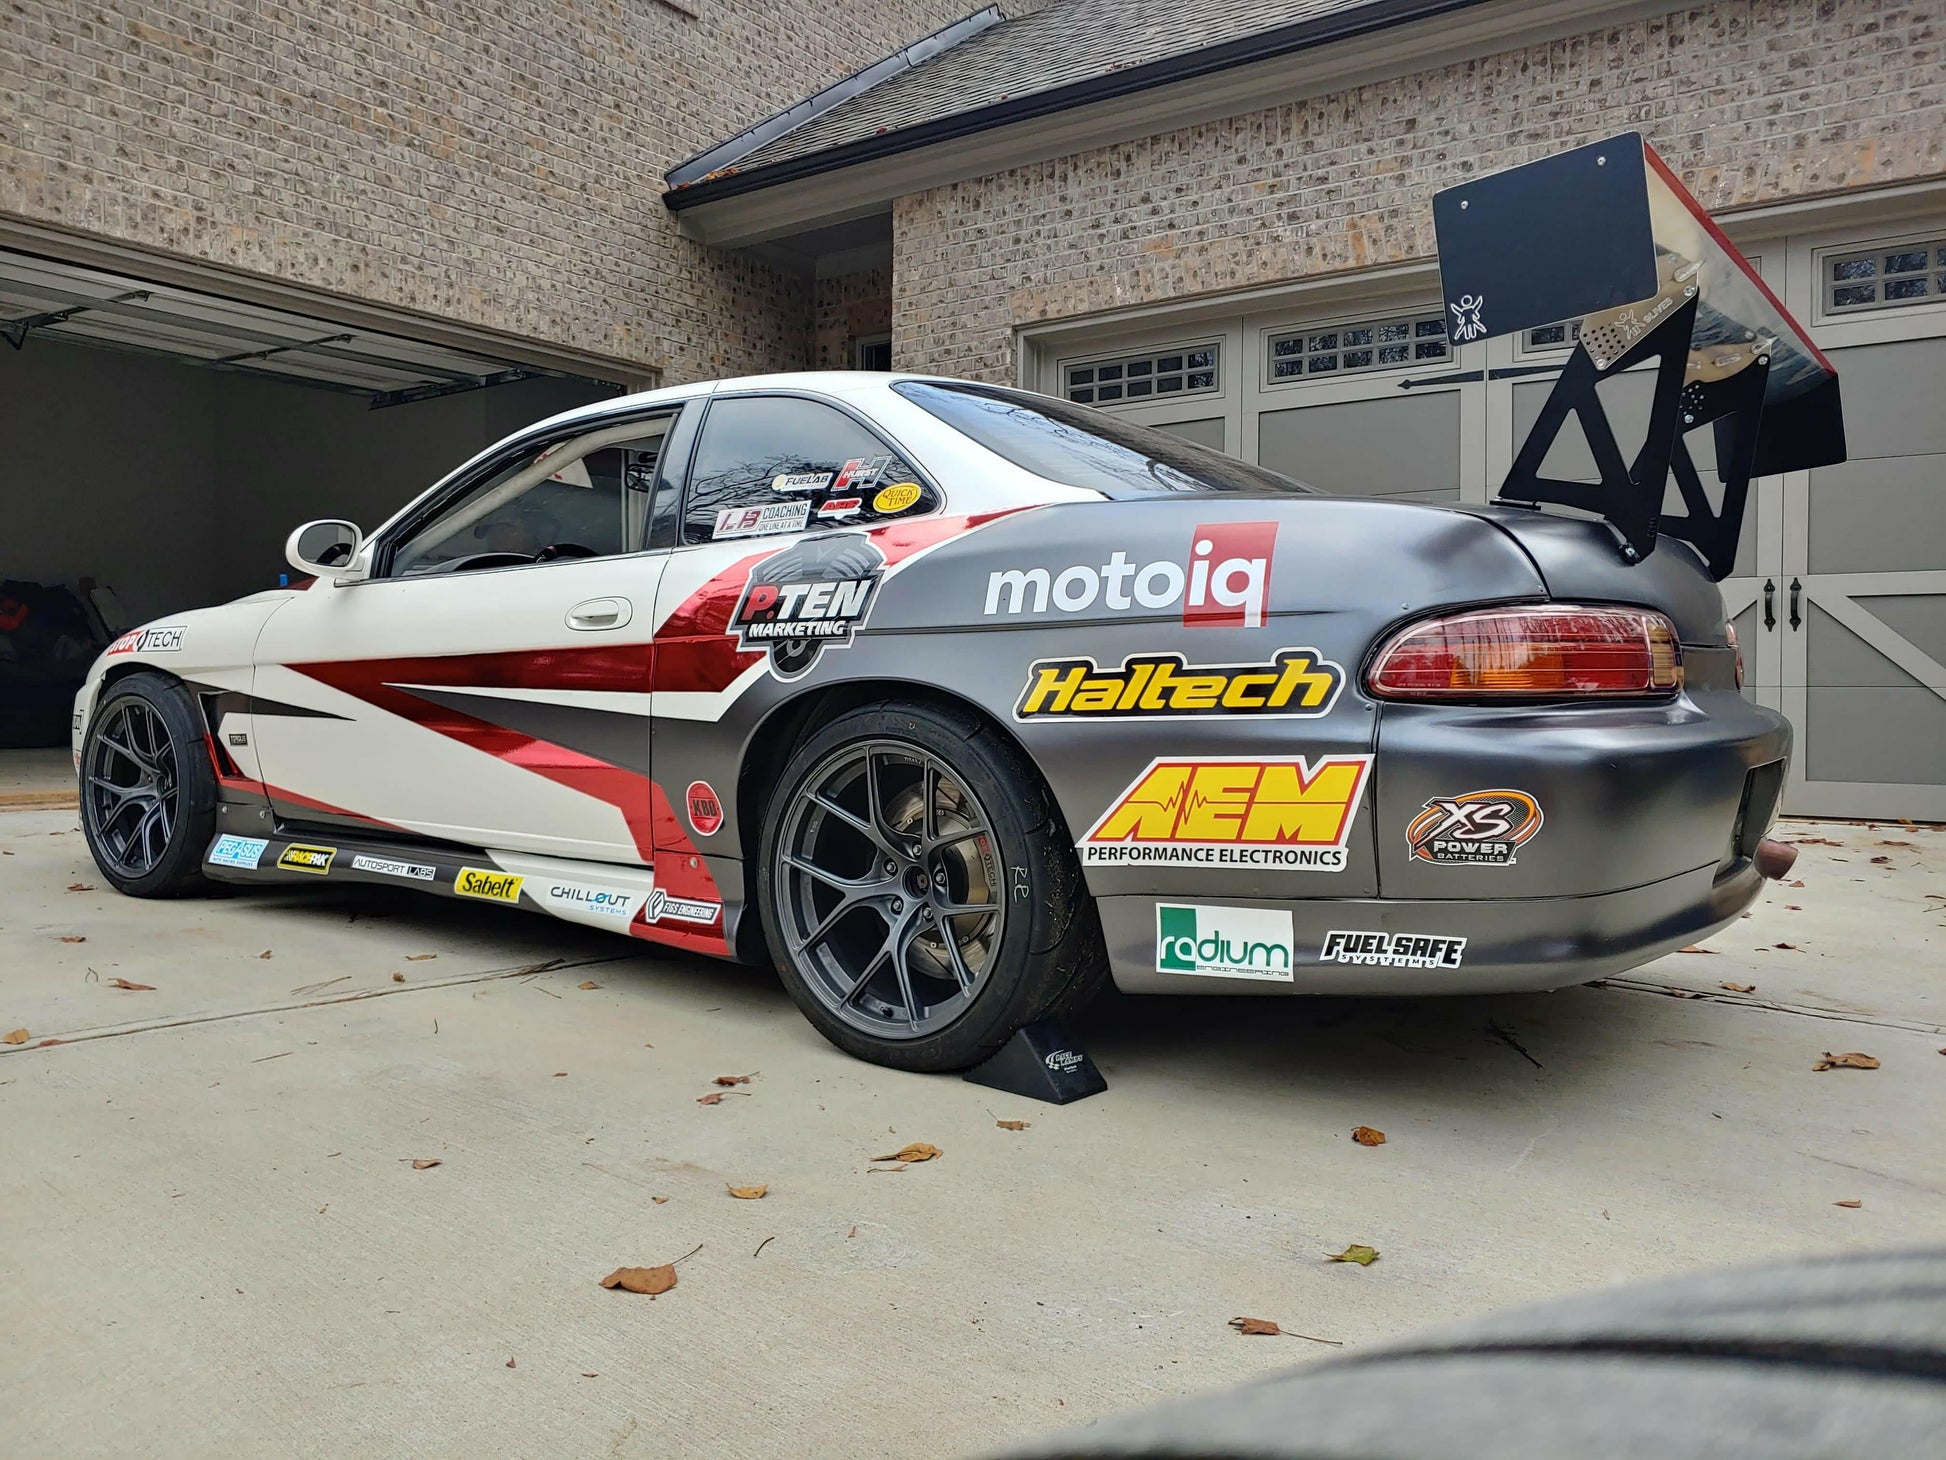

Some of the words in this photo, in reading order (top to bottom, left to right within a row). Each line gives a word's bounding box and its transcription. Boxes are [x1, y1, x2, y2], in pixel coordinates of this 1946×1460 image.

[785, 475, 829, 486] FUELAB
[843, 468, 879, 478] HURST
[883, 488, 915, 499] QUICK
[888, 497, 913, 506] TIME
[762, 503, 808, 520] COACHING
[983, 539, 1267, 628] motoiq
[741, 579, 872, 621] P.TEN
[749, 620, 848, 638] MARKETING
[1022, 659, 1333, 712] Haltech
[1091, 763, 1362, 844] AEM
[1415, 802, 1513, 846] XS
[217, 841, 262, 858] PEGASUS
[1088, 847, 1214, 862] PERFORMANCE
[1218, 849, 1342, 866] ELECTRONICS
[1433, 840, 1508, 855] POWER
[1437, 852, 1504, 862] BATTERIES
[354, 859, 406, 874] AUTOSPORT
[408, 866, 433, 878] LABS
[462, 872, 516, 898] Sabelt
[551, 886, 631, 907] CHILLOUT
[589, 905, 627, 916] SYSTEMS
[677, 904, 714, 919] ENGINEERING
[1160, 930, 1289, 968] radium
[1324, 934, 1388, 957] FUEL
[1393, 937, 1463, 965] SAFE
[1341, 955, 1434, 966] SYSTEMS
